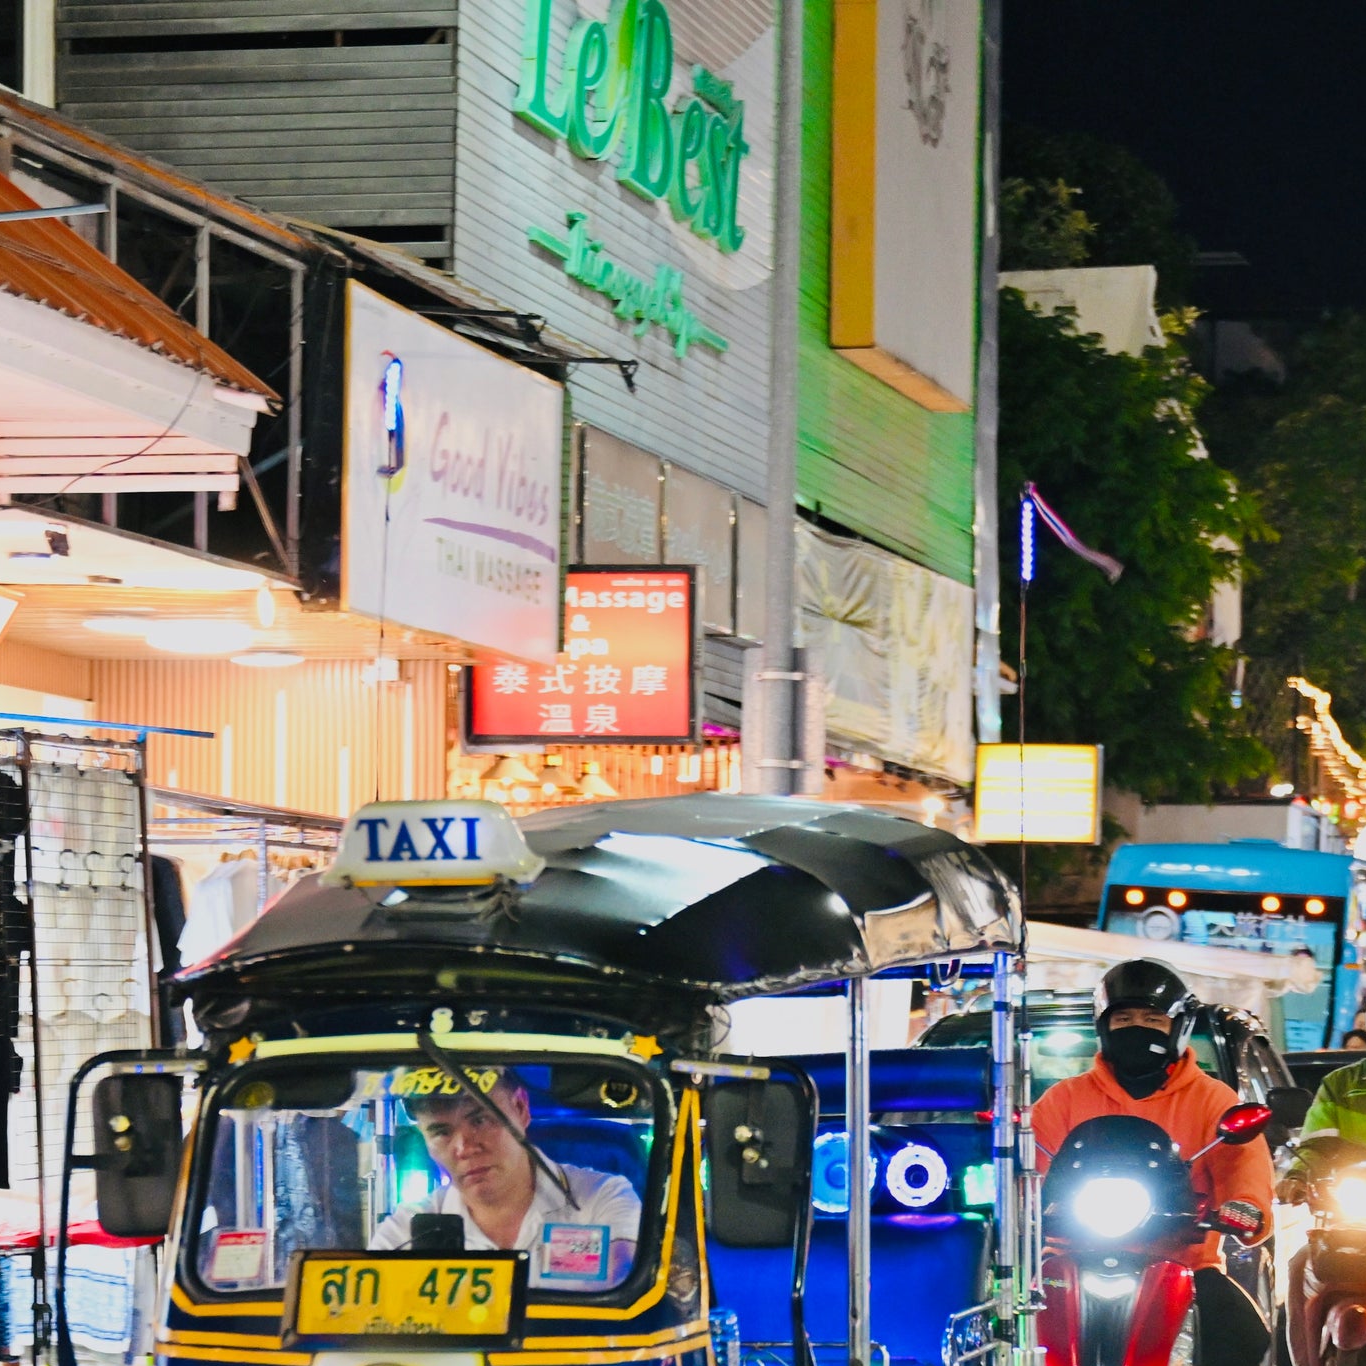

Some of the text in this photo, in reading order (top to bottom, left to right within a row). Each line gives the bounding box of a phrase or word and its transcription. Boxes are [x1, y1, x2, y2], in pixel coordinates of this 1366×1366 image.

[429, 411, 490, 505] Good
[570, 614, 591, 632] &
[564, 637, 610, 661] pa
[492, 663, 669, 696] 泰式按摩
[356, 816, 482, 863] TAXI
[418, 1267, 494, 1305] 475
